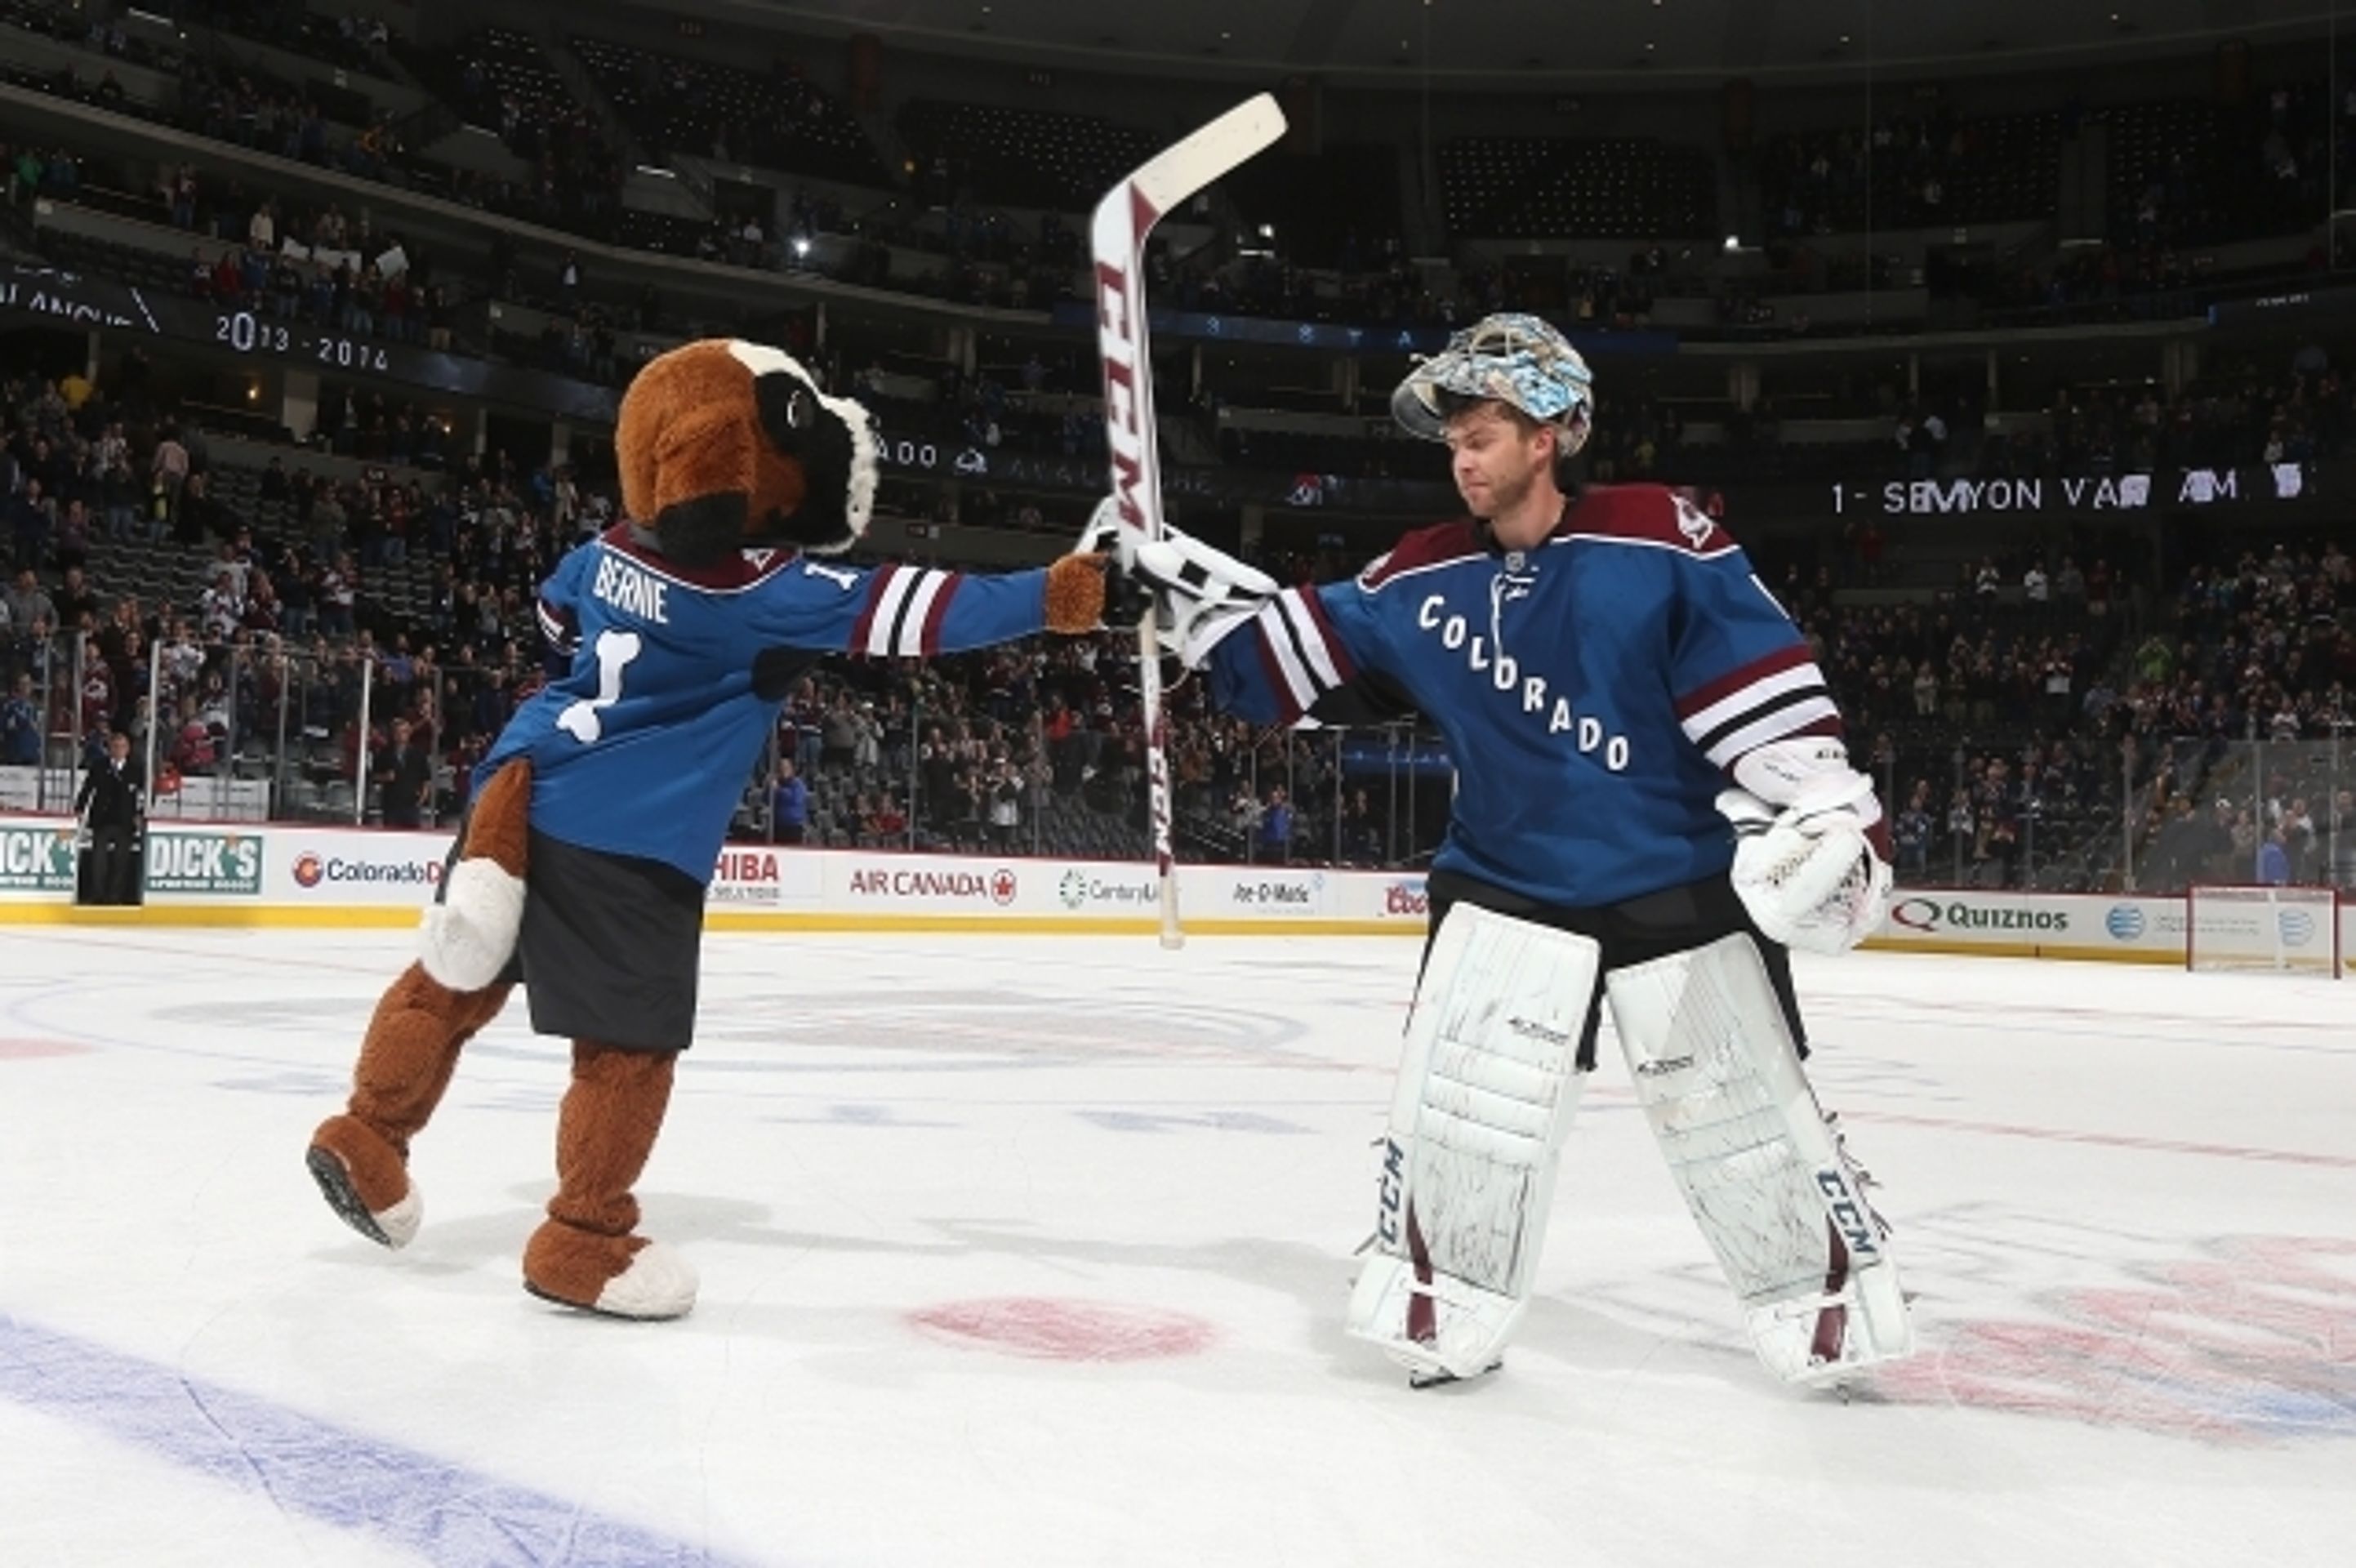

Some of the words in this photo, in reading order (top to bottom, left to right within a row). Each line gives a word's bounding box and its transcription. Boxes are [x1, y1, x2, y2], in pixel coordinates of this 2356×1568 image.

[216, 312, 288, 351] 2013
[1095, 261, 1145, 530] CCM
[592, 555, 670, 623] BERNIE
[1418, 595, 1628, 770] COLORADO
[149, 835, 256, 878] DICK'S
[712, 853, 779, 882] HIBA
[850, 870, 888, 894] AIR
[894, 871, 987, 898] CANADA
[1386, 884, 1427, 914] Coo
[1378, 1138, 1404, 1245] CCM
[1817, 1169, 1877, 1255] CCM
